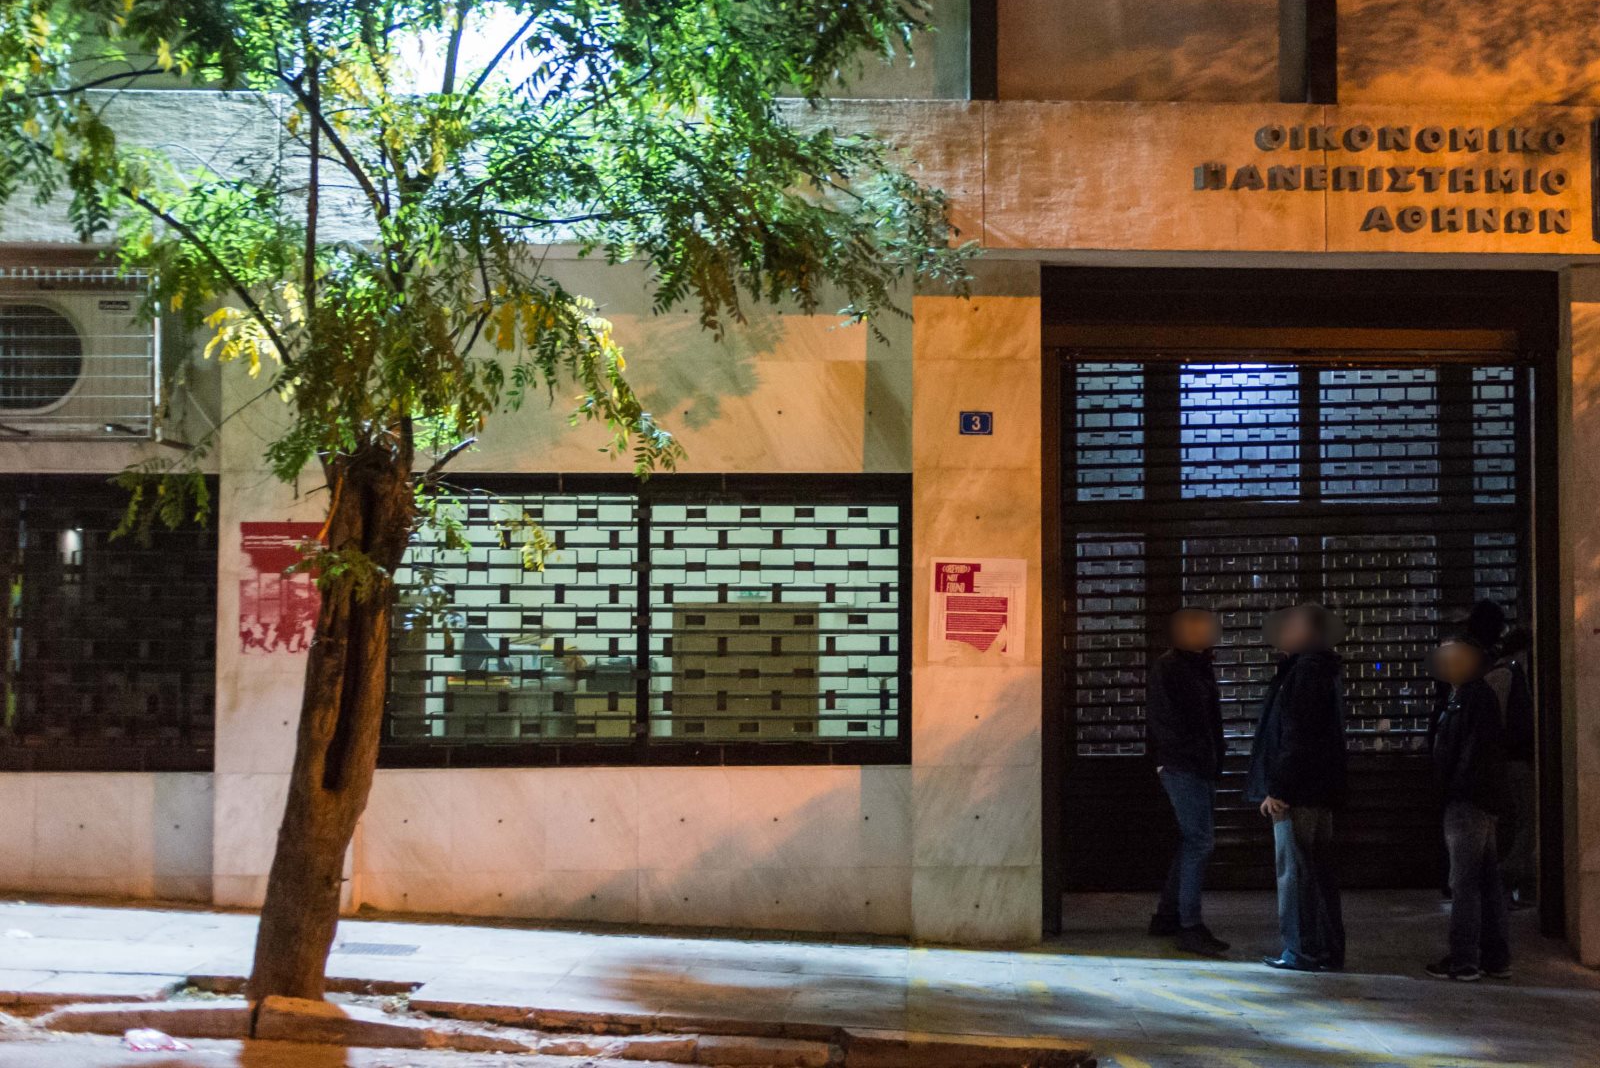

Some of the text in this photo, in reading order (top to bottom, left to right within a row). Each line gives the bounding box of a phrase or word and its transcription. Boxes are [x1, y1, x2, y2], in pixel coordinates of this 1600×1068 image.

[1255, 123, 1570, 155] ΟΙΚΟΝΟΜΙΚΟ
[1193, 162, 1571, 195] ΠΑΝΕΠΙΣΤΗΜΙΟ
[1359, 205, 1572, 234] ΑΘΗΝΩΝ
[971, 415, 981, 431] 3
